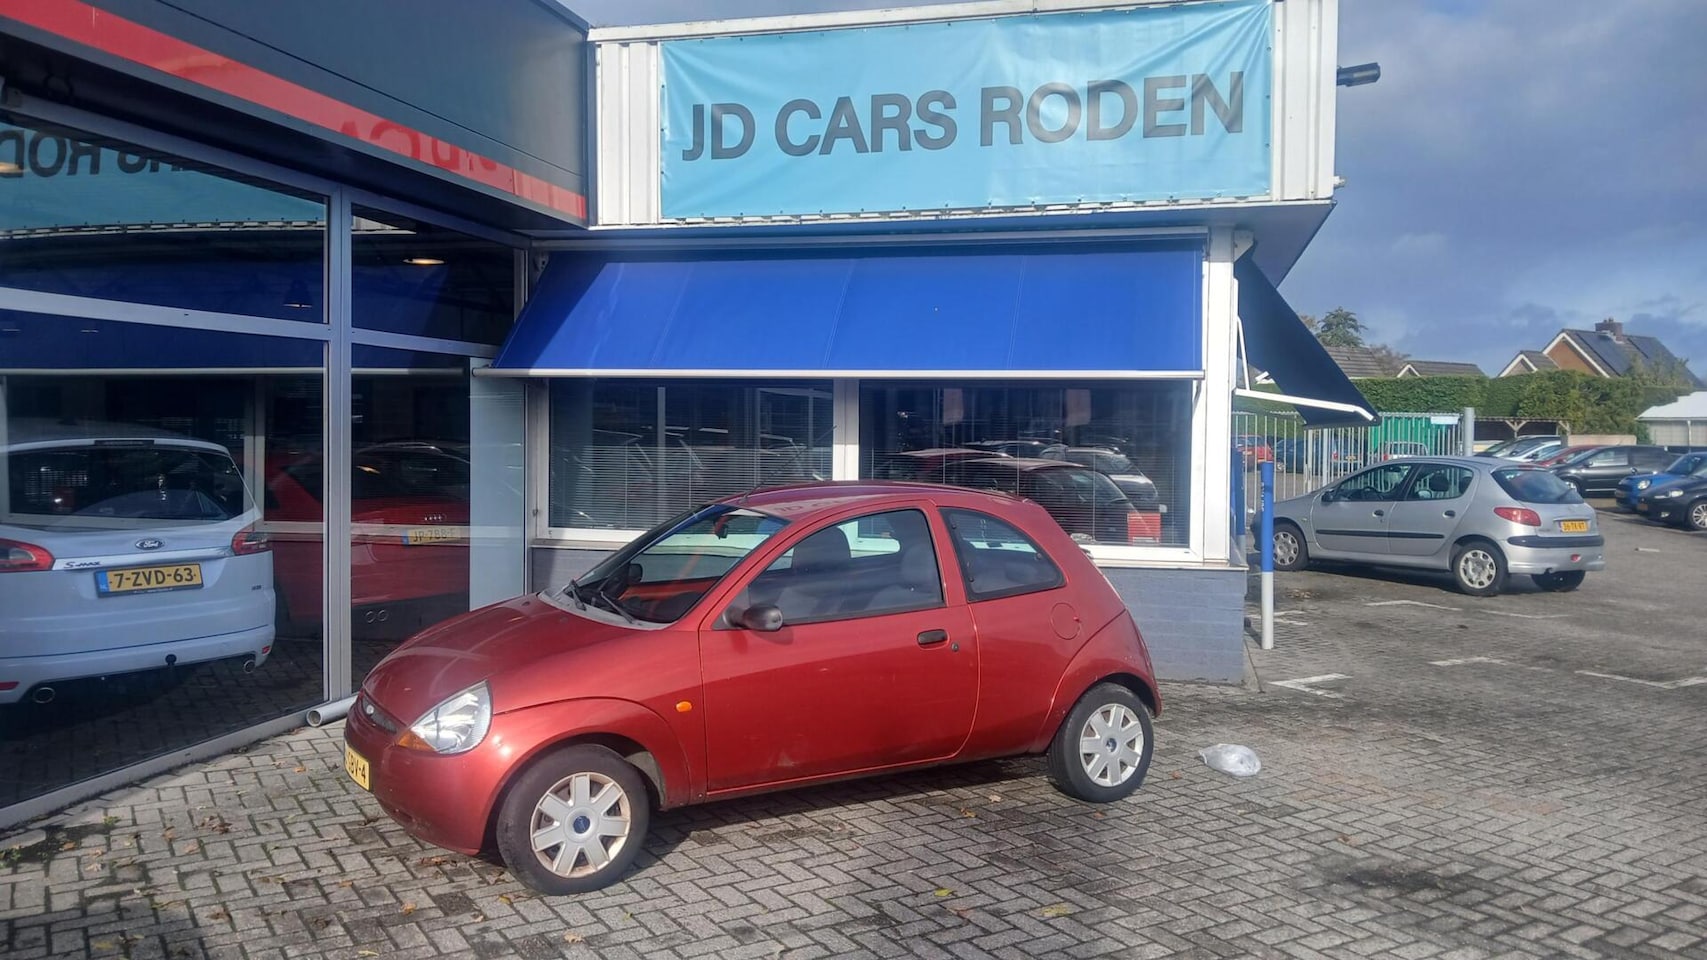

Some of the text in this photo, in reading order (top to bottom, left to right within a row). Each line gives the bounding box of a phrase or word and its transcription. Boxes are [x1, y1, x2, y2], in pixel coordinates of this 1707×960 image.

[682, 70, 1245, 162] JD CARS RODEN
[113, 567, 194, 588] 7-ZVD-63
